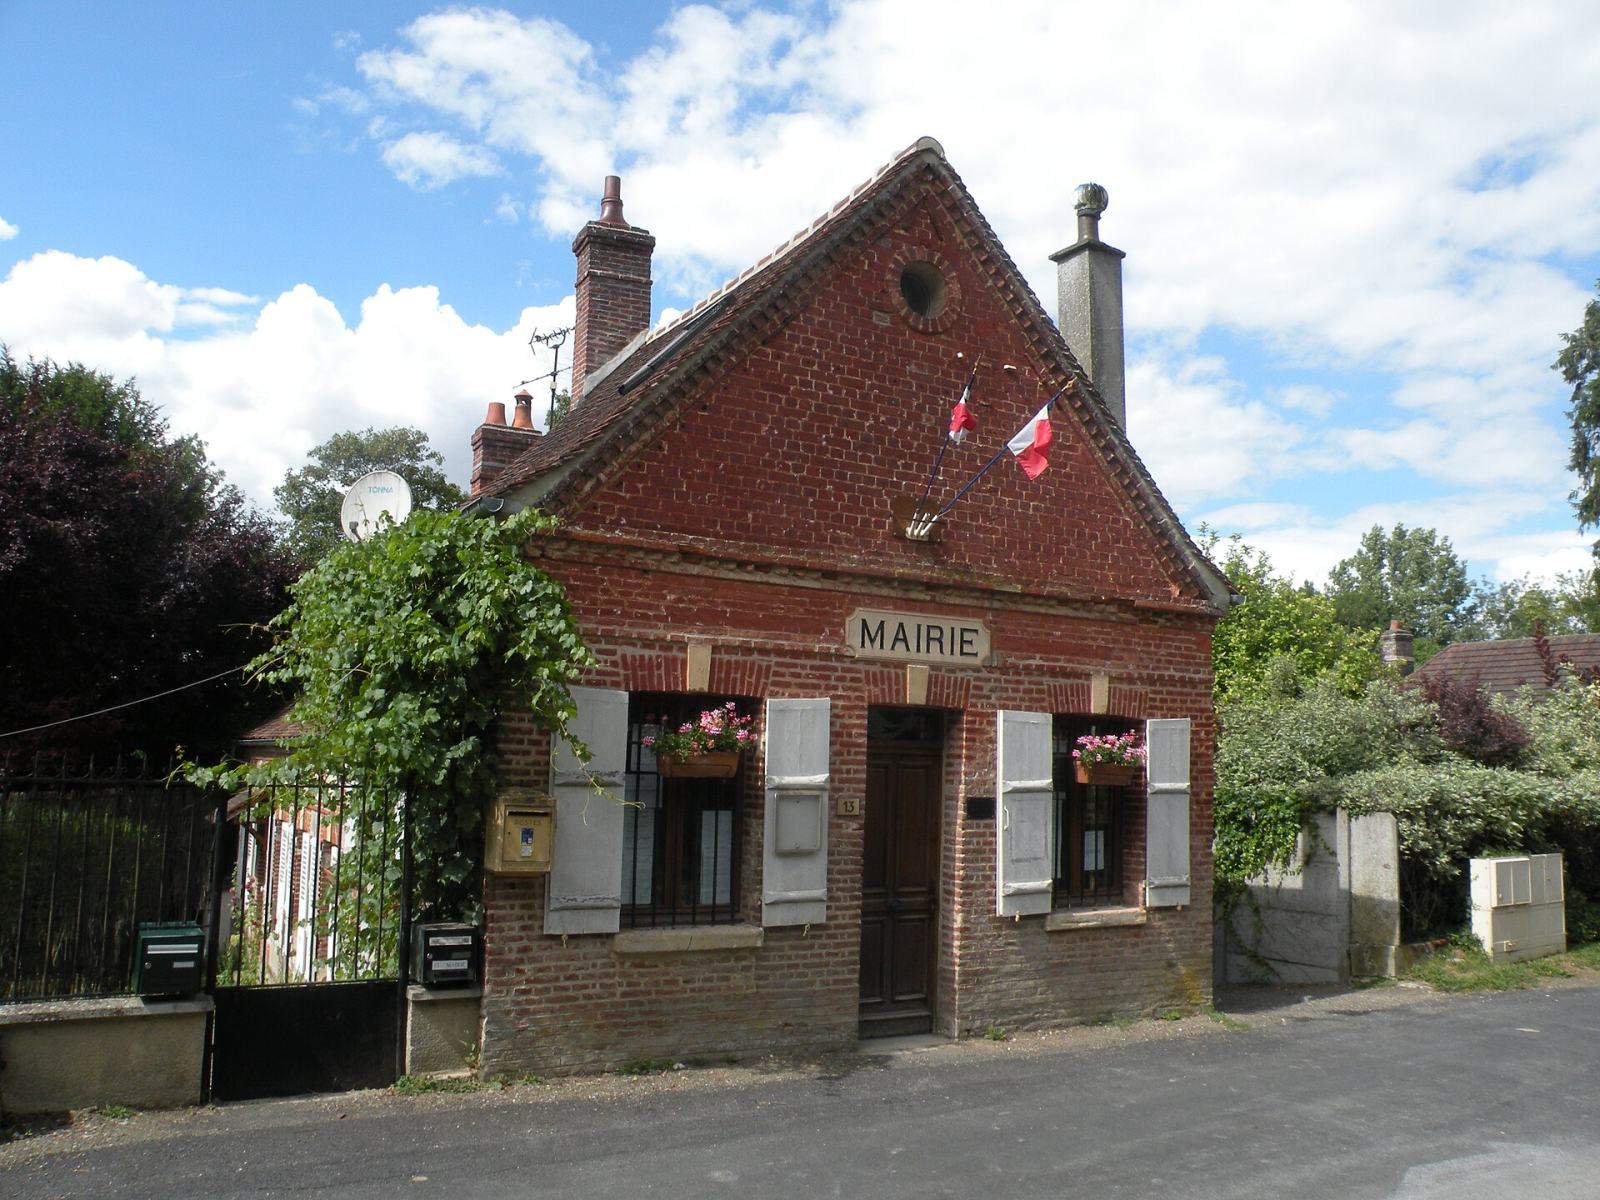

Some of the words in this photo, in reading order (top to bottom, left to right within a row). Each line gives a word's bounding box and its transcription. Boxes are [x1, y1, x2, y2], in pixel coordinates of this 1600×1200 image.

[368, 486, 394, 494] TONNA
[860, 618, 978, 657] MAIRIE
[842, 800, 854, 813] 13
